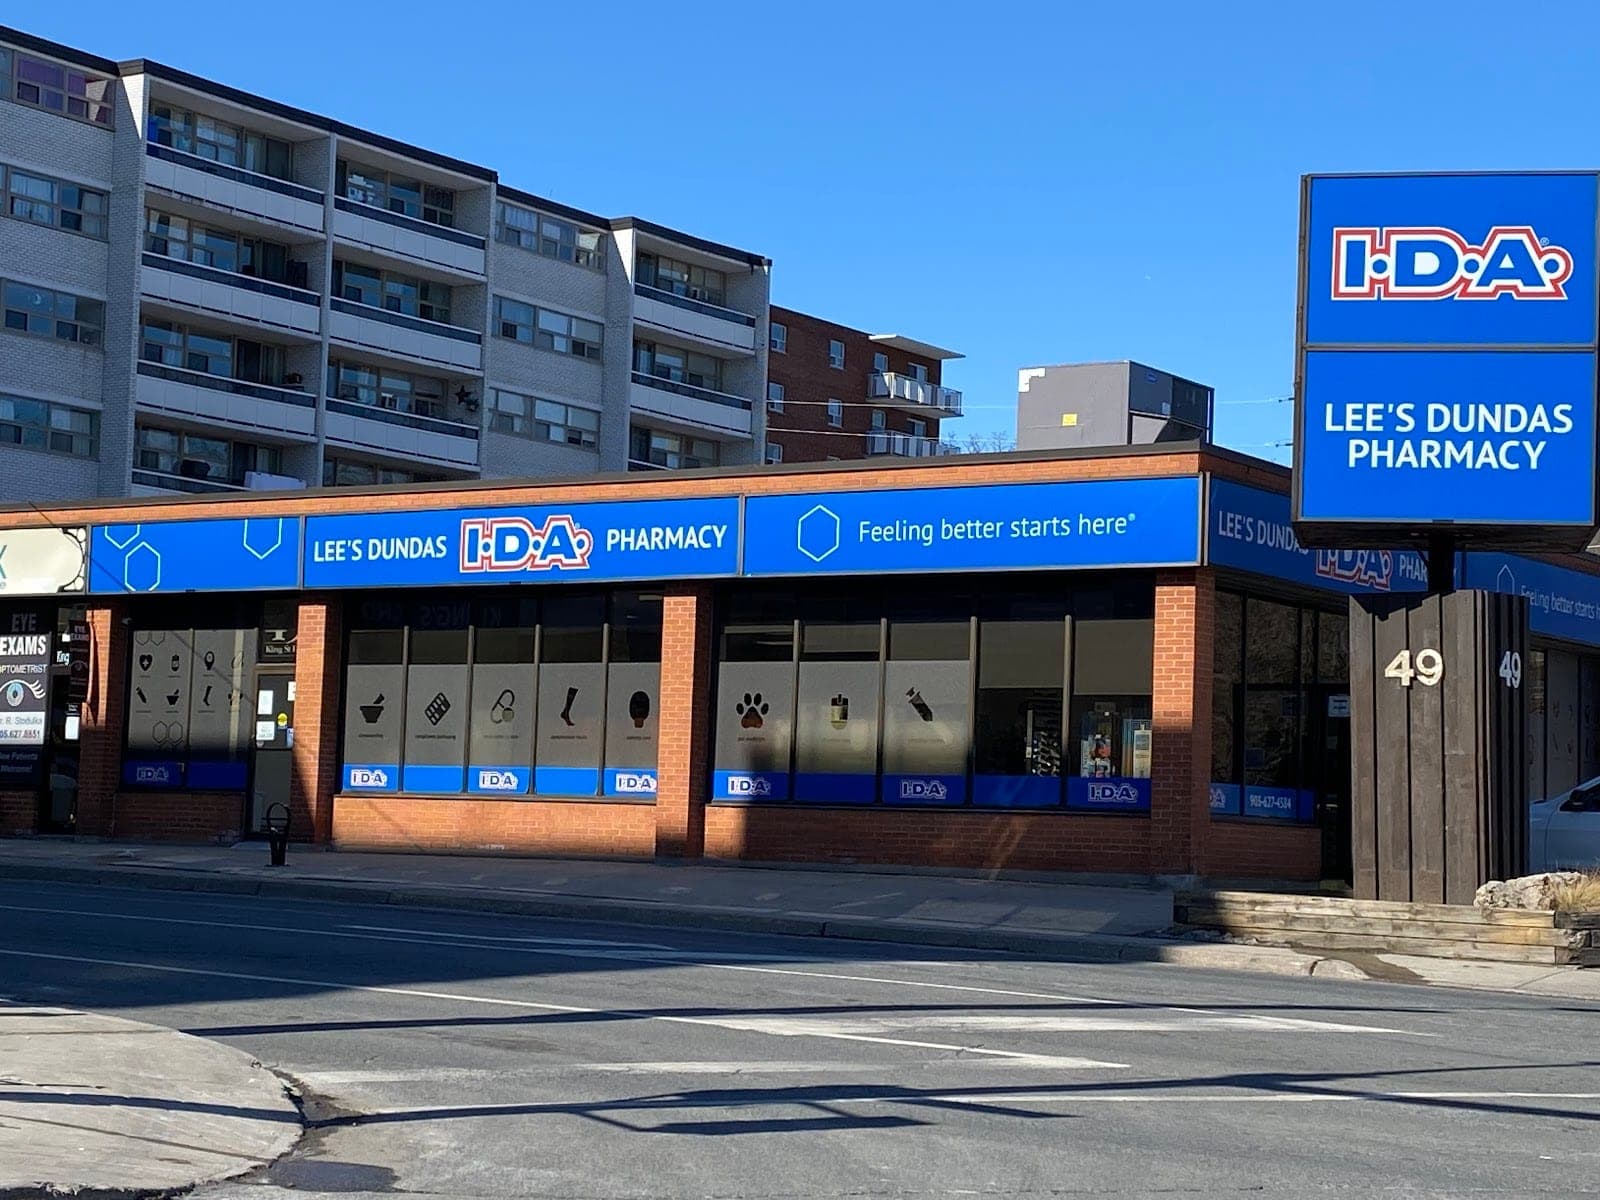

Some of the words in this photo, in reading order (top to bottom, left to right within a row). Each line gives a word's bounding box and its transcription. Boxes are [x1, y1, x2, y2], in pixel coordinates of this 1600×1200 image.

[1325, 403, 1415, 432] LEE'S
[1427, 403, 1573, 433] DUNDAS
[1348, 440, 1546, 470] PHARMACY
[314, 538, 362, 562] LEE'S
[368, 536, 447, 560] DUNDAS
[606, 525, 728, 551] PHARMACY
[859, 519, 933, 546] Feeling
[941, 518, 1004, 540] better
[1010, 516, 1070, 538] starts
[1218, 510, 1254, 542] LEE'S
[1257, 520, 1309, 555] DUND
[1551, 592, 1575, 616] better
[1575, 601, 1595, 620] starts
[12, 613, 37, 633] EYE
[0, 635, 46, 656] EXAMS
[0, 664, 47, 674] PTOMETRIST
[1385, 649, 1443, 687] 49
[1499, 650, 1521, 688] 49
